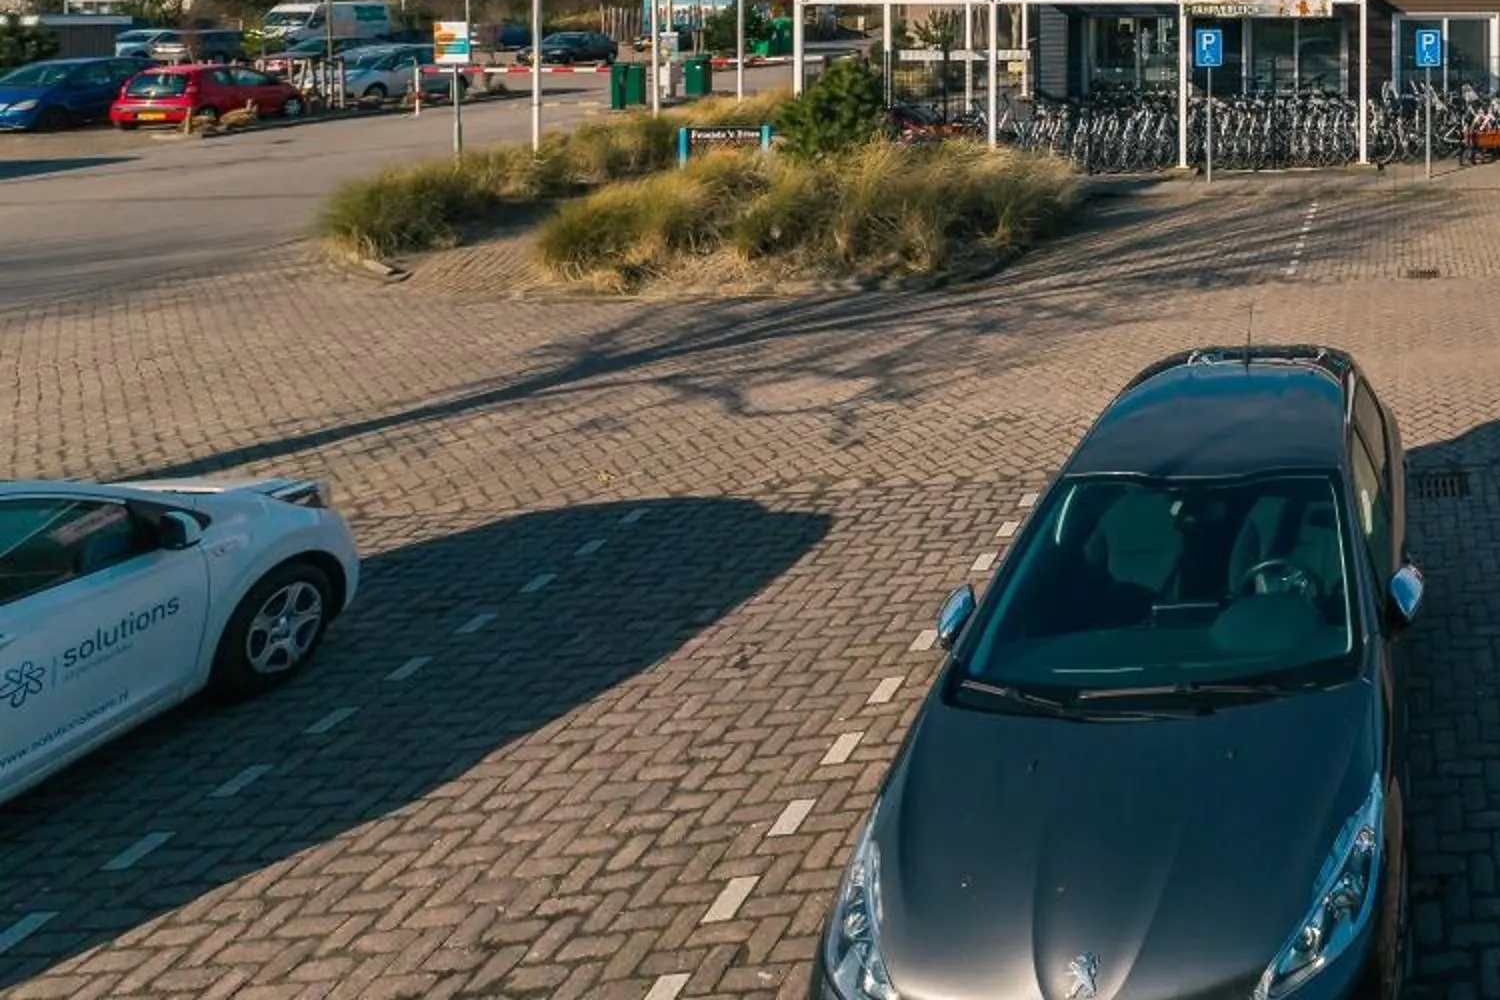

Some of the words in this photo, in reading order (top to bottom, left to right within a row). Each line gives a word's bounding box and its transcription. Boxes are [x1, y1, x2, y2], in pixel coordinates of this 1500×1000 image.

[1202, 33, 1215, 50] P
[1422, 33, 1435, 50] P
[63, 596, 180, 667] solutions
